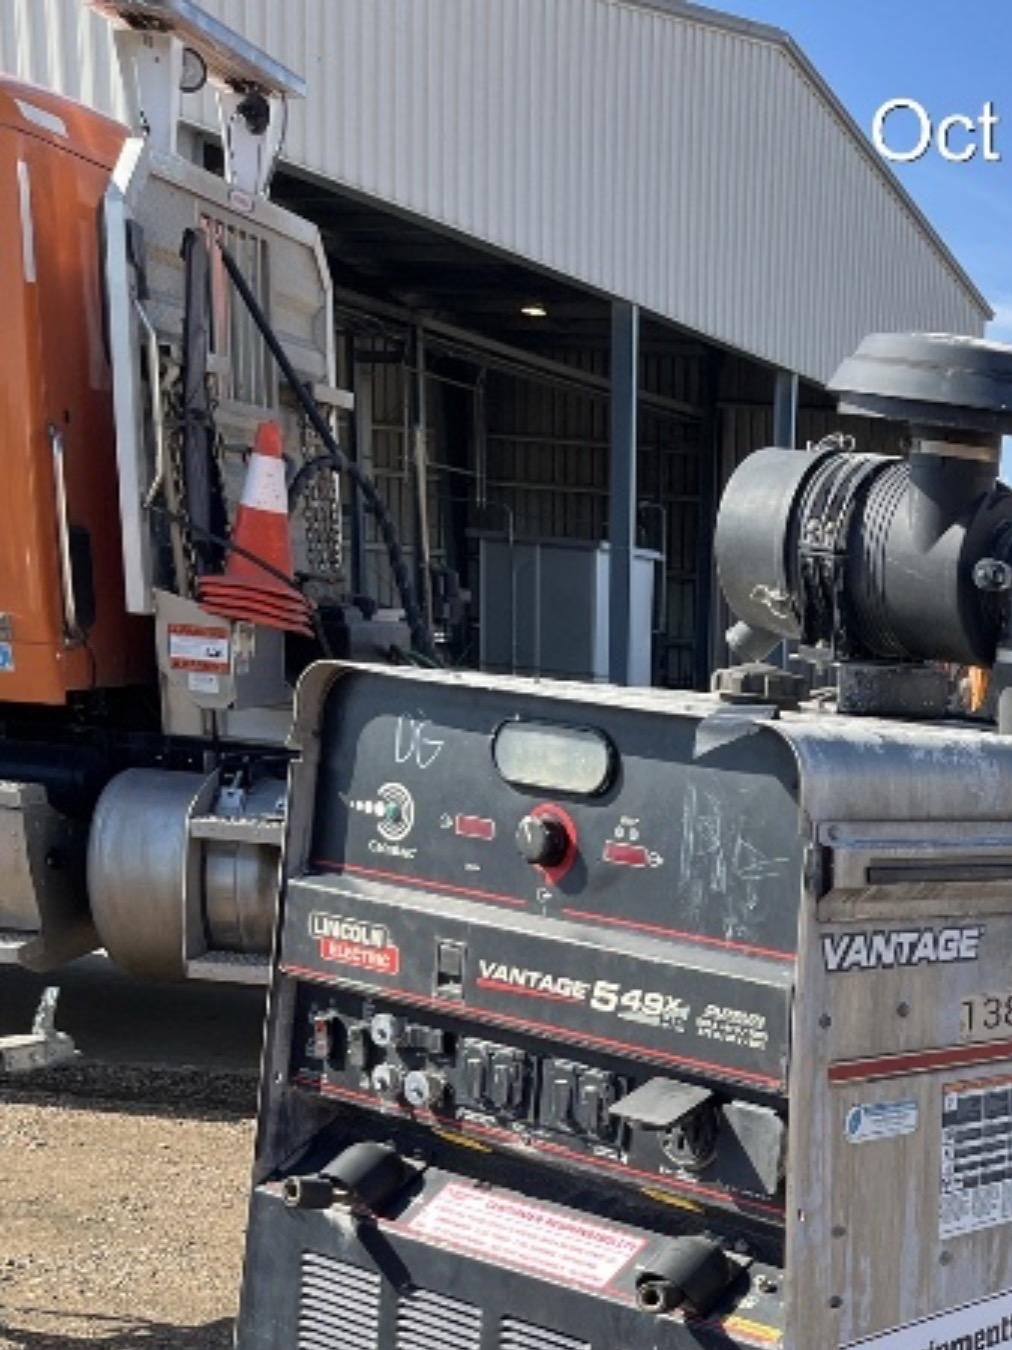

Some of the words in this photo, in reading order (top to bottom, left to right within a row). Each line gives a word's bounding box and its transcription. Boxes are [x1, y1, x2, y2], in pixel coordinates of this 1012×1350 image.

[312, 915, 386, 949] LINCOLN
[822, 927, 981, 972] VANTAGE
[480, 959, 590, 1000] VANTAGE
